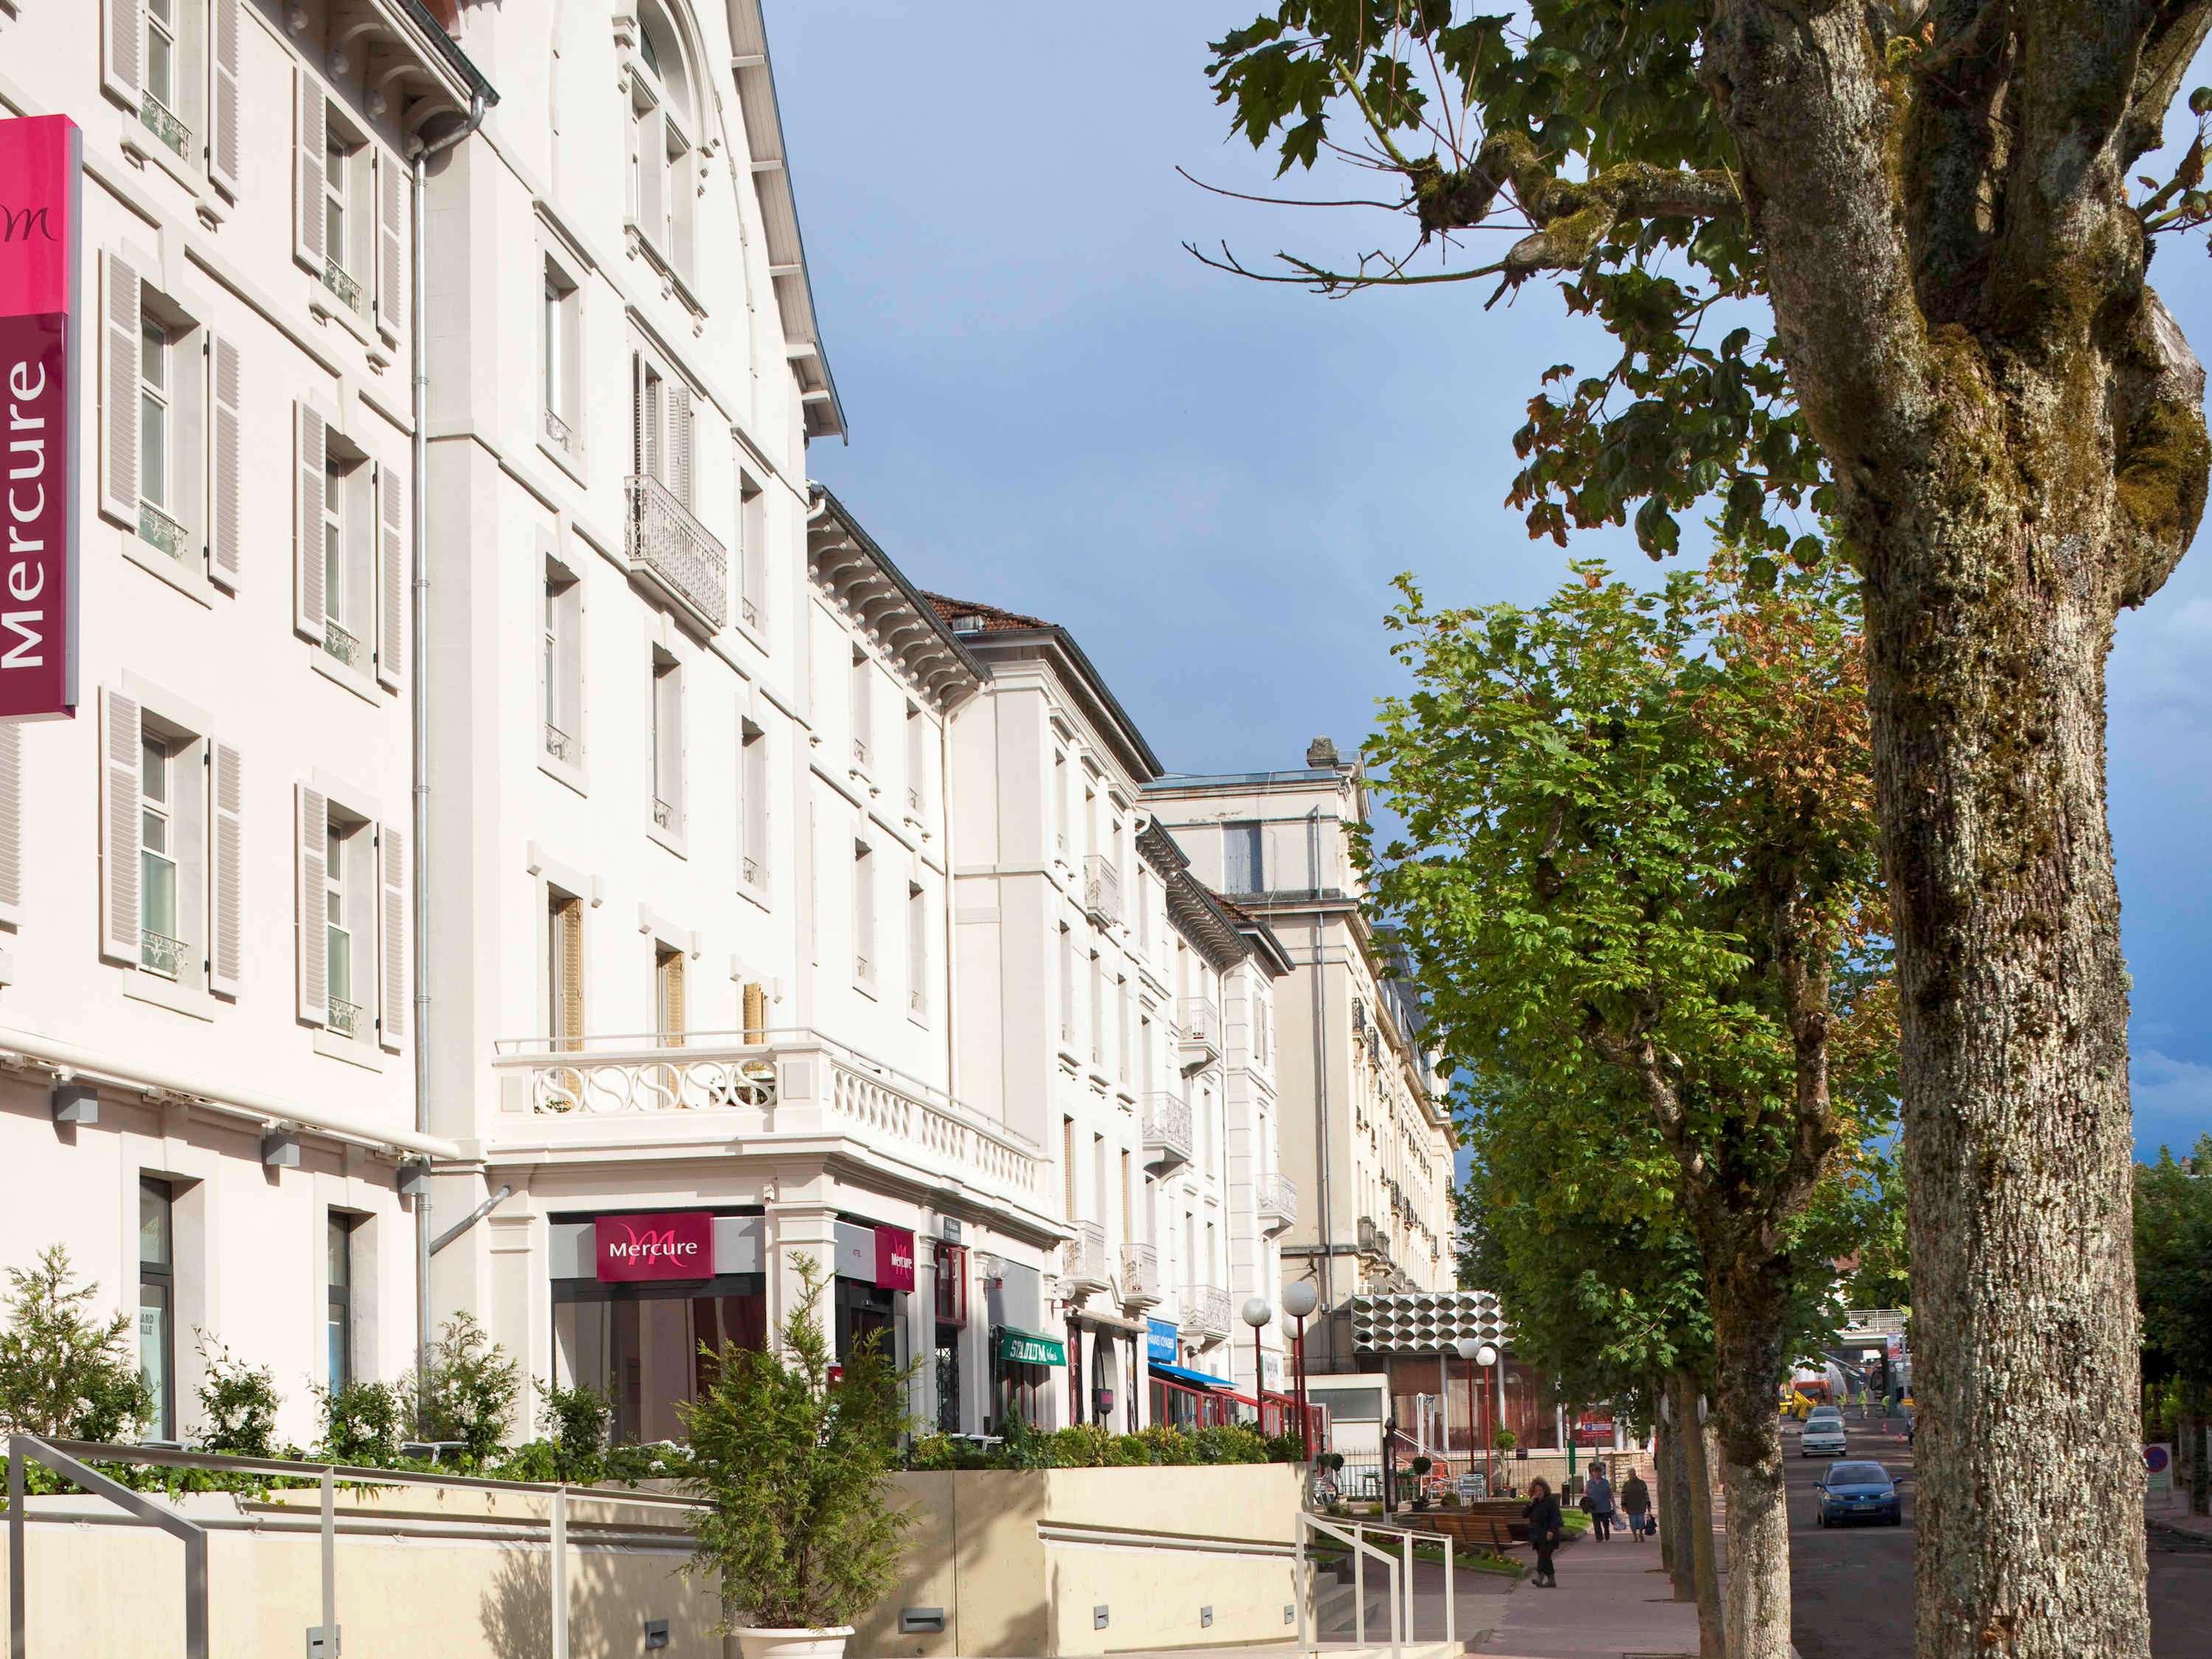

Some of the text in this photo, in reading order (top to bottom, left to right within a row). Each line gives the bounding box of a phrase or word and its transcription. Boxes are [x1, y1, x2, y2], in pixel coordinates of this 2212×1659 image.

[1, 361, 46, 669] Mercure
[609, 1241, 698, 1258] Mercure
[891, 1251, 913, 1270] Mercure
[1009, 1339, 1048, 1363] STADIUM
